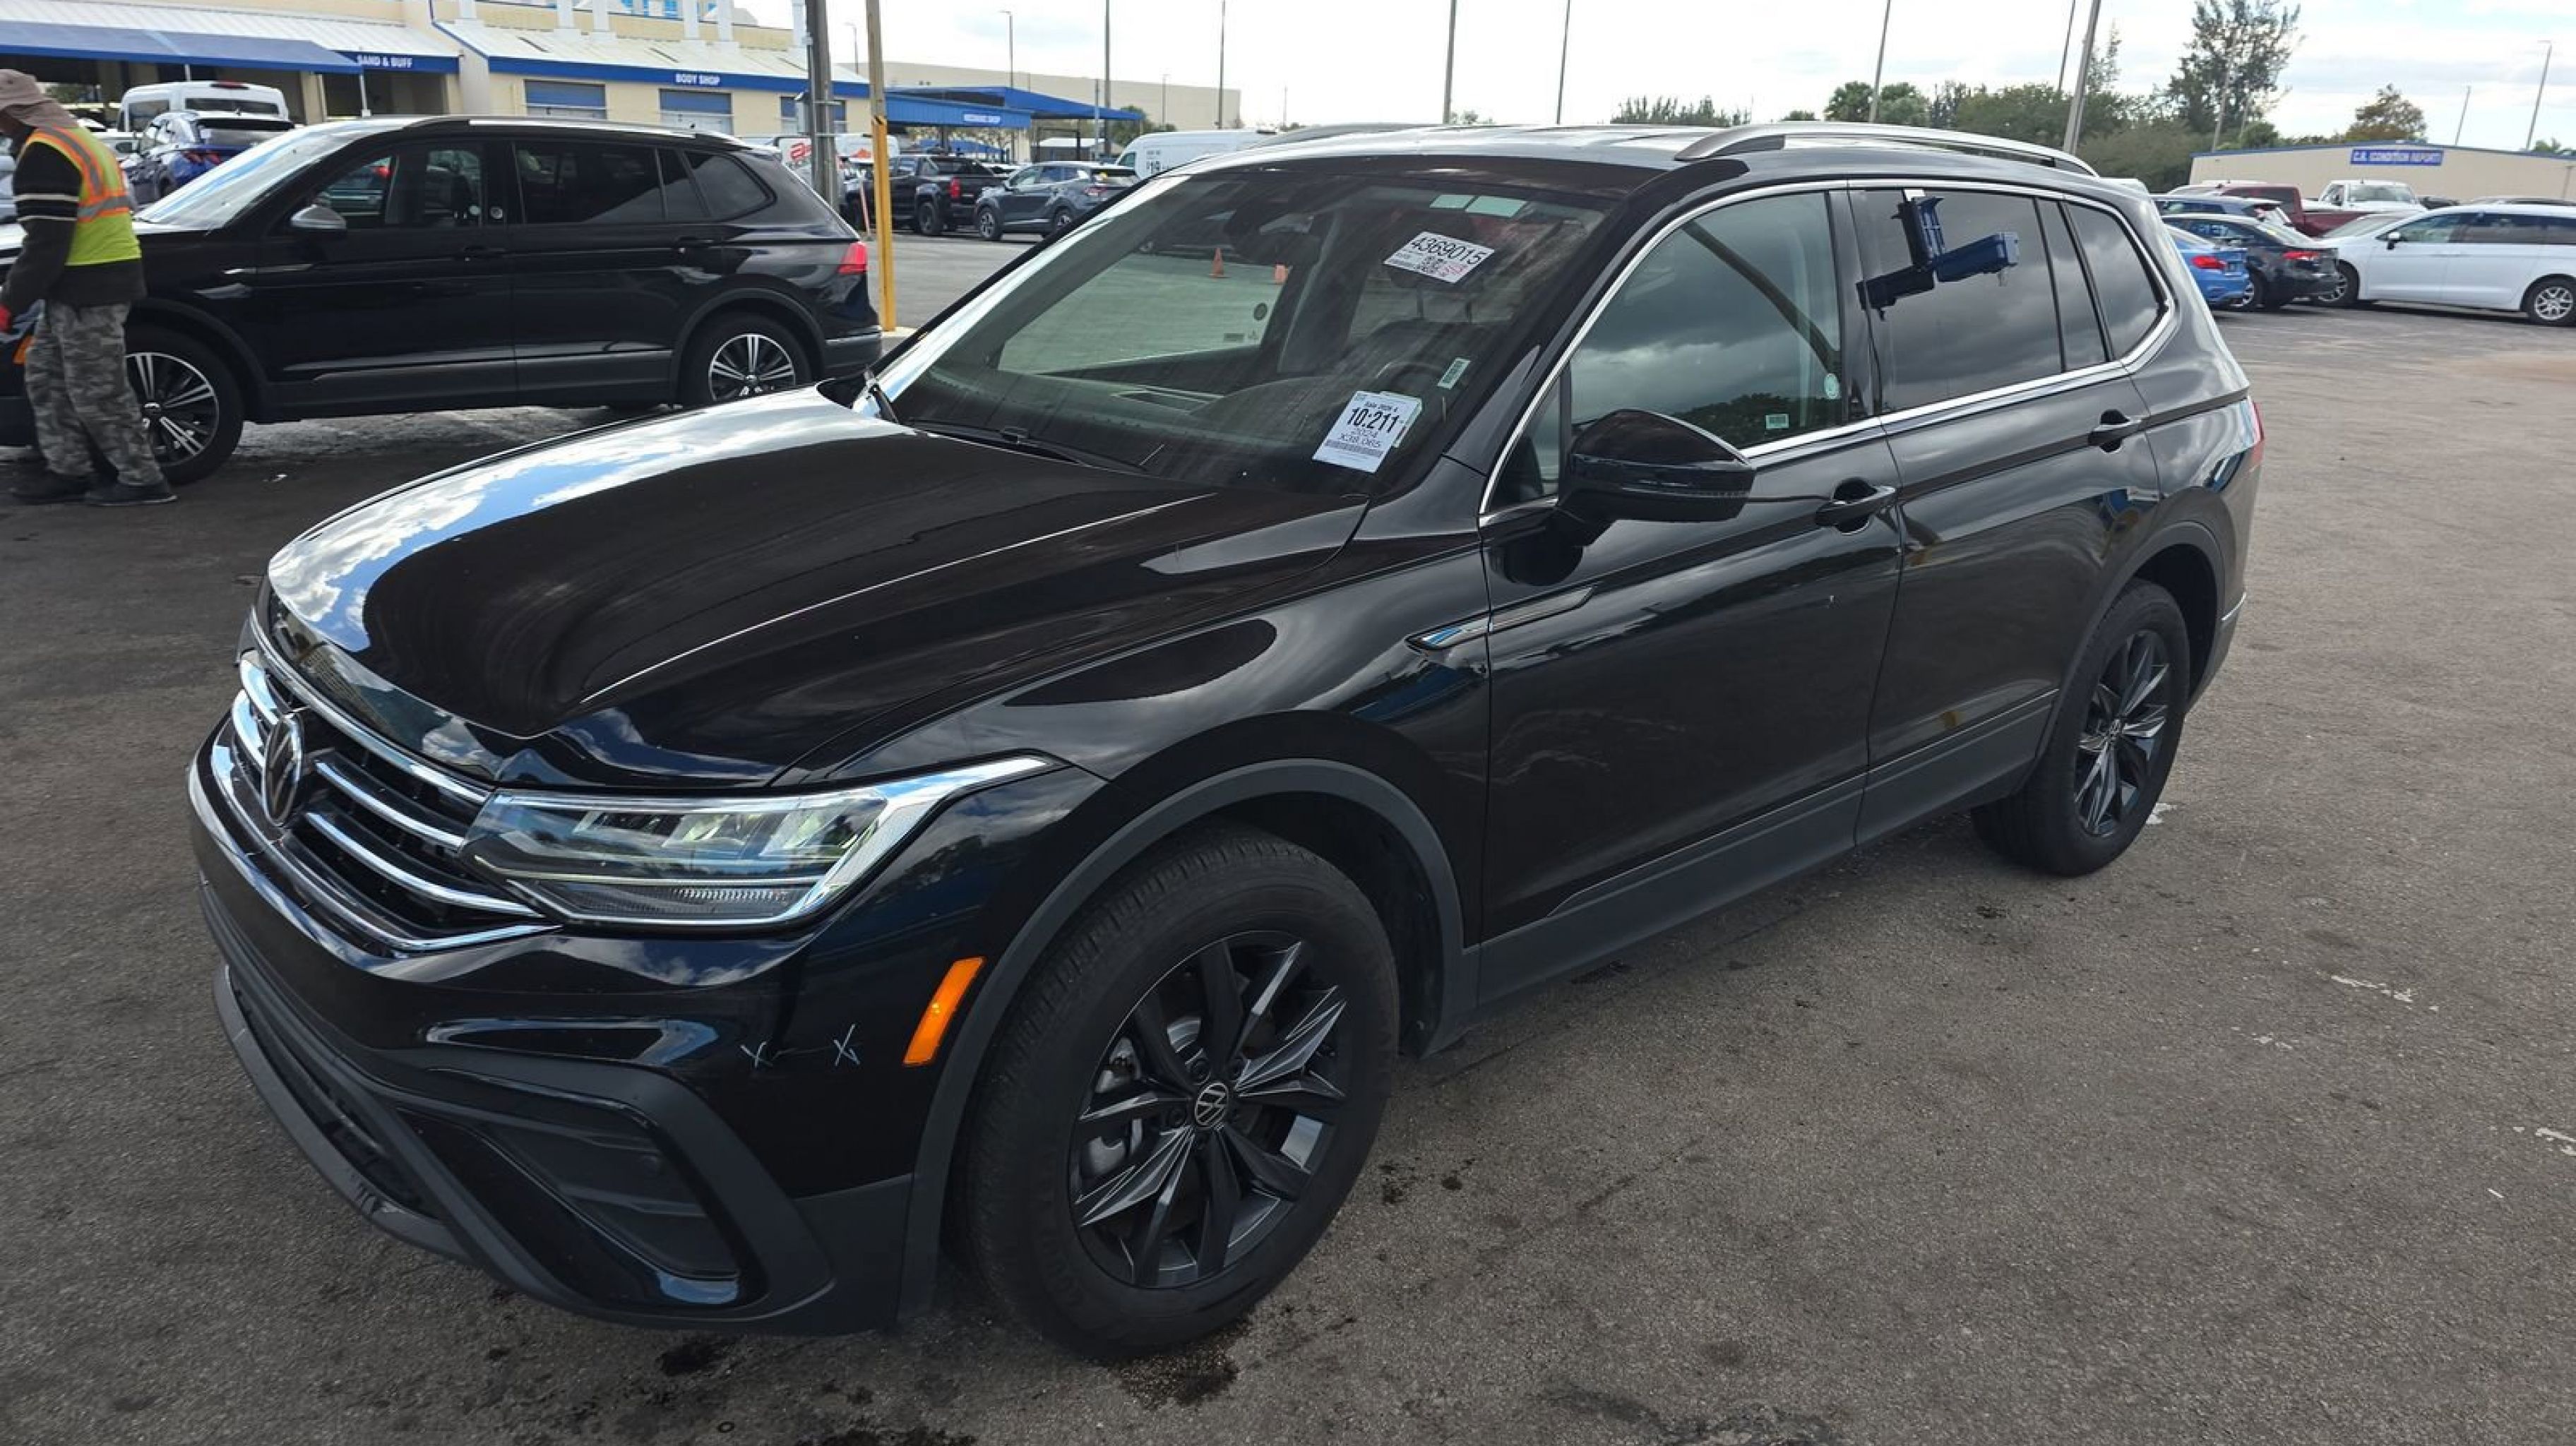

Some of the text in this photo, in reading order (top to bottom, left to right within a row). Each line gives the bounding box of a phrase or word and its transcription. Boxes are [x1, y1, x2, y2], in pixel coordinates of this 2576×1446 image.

[698, 74, 720, 85] SHOP
[1411, 237, 1487, 265] 4369015
[1347, 407, 1400, 433] 10:211
